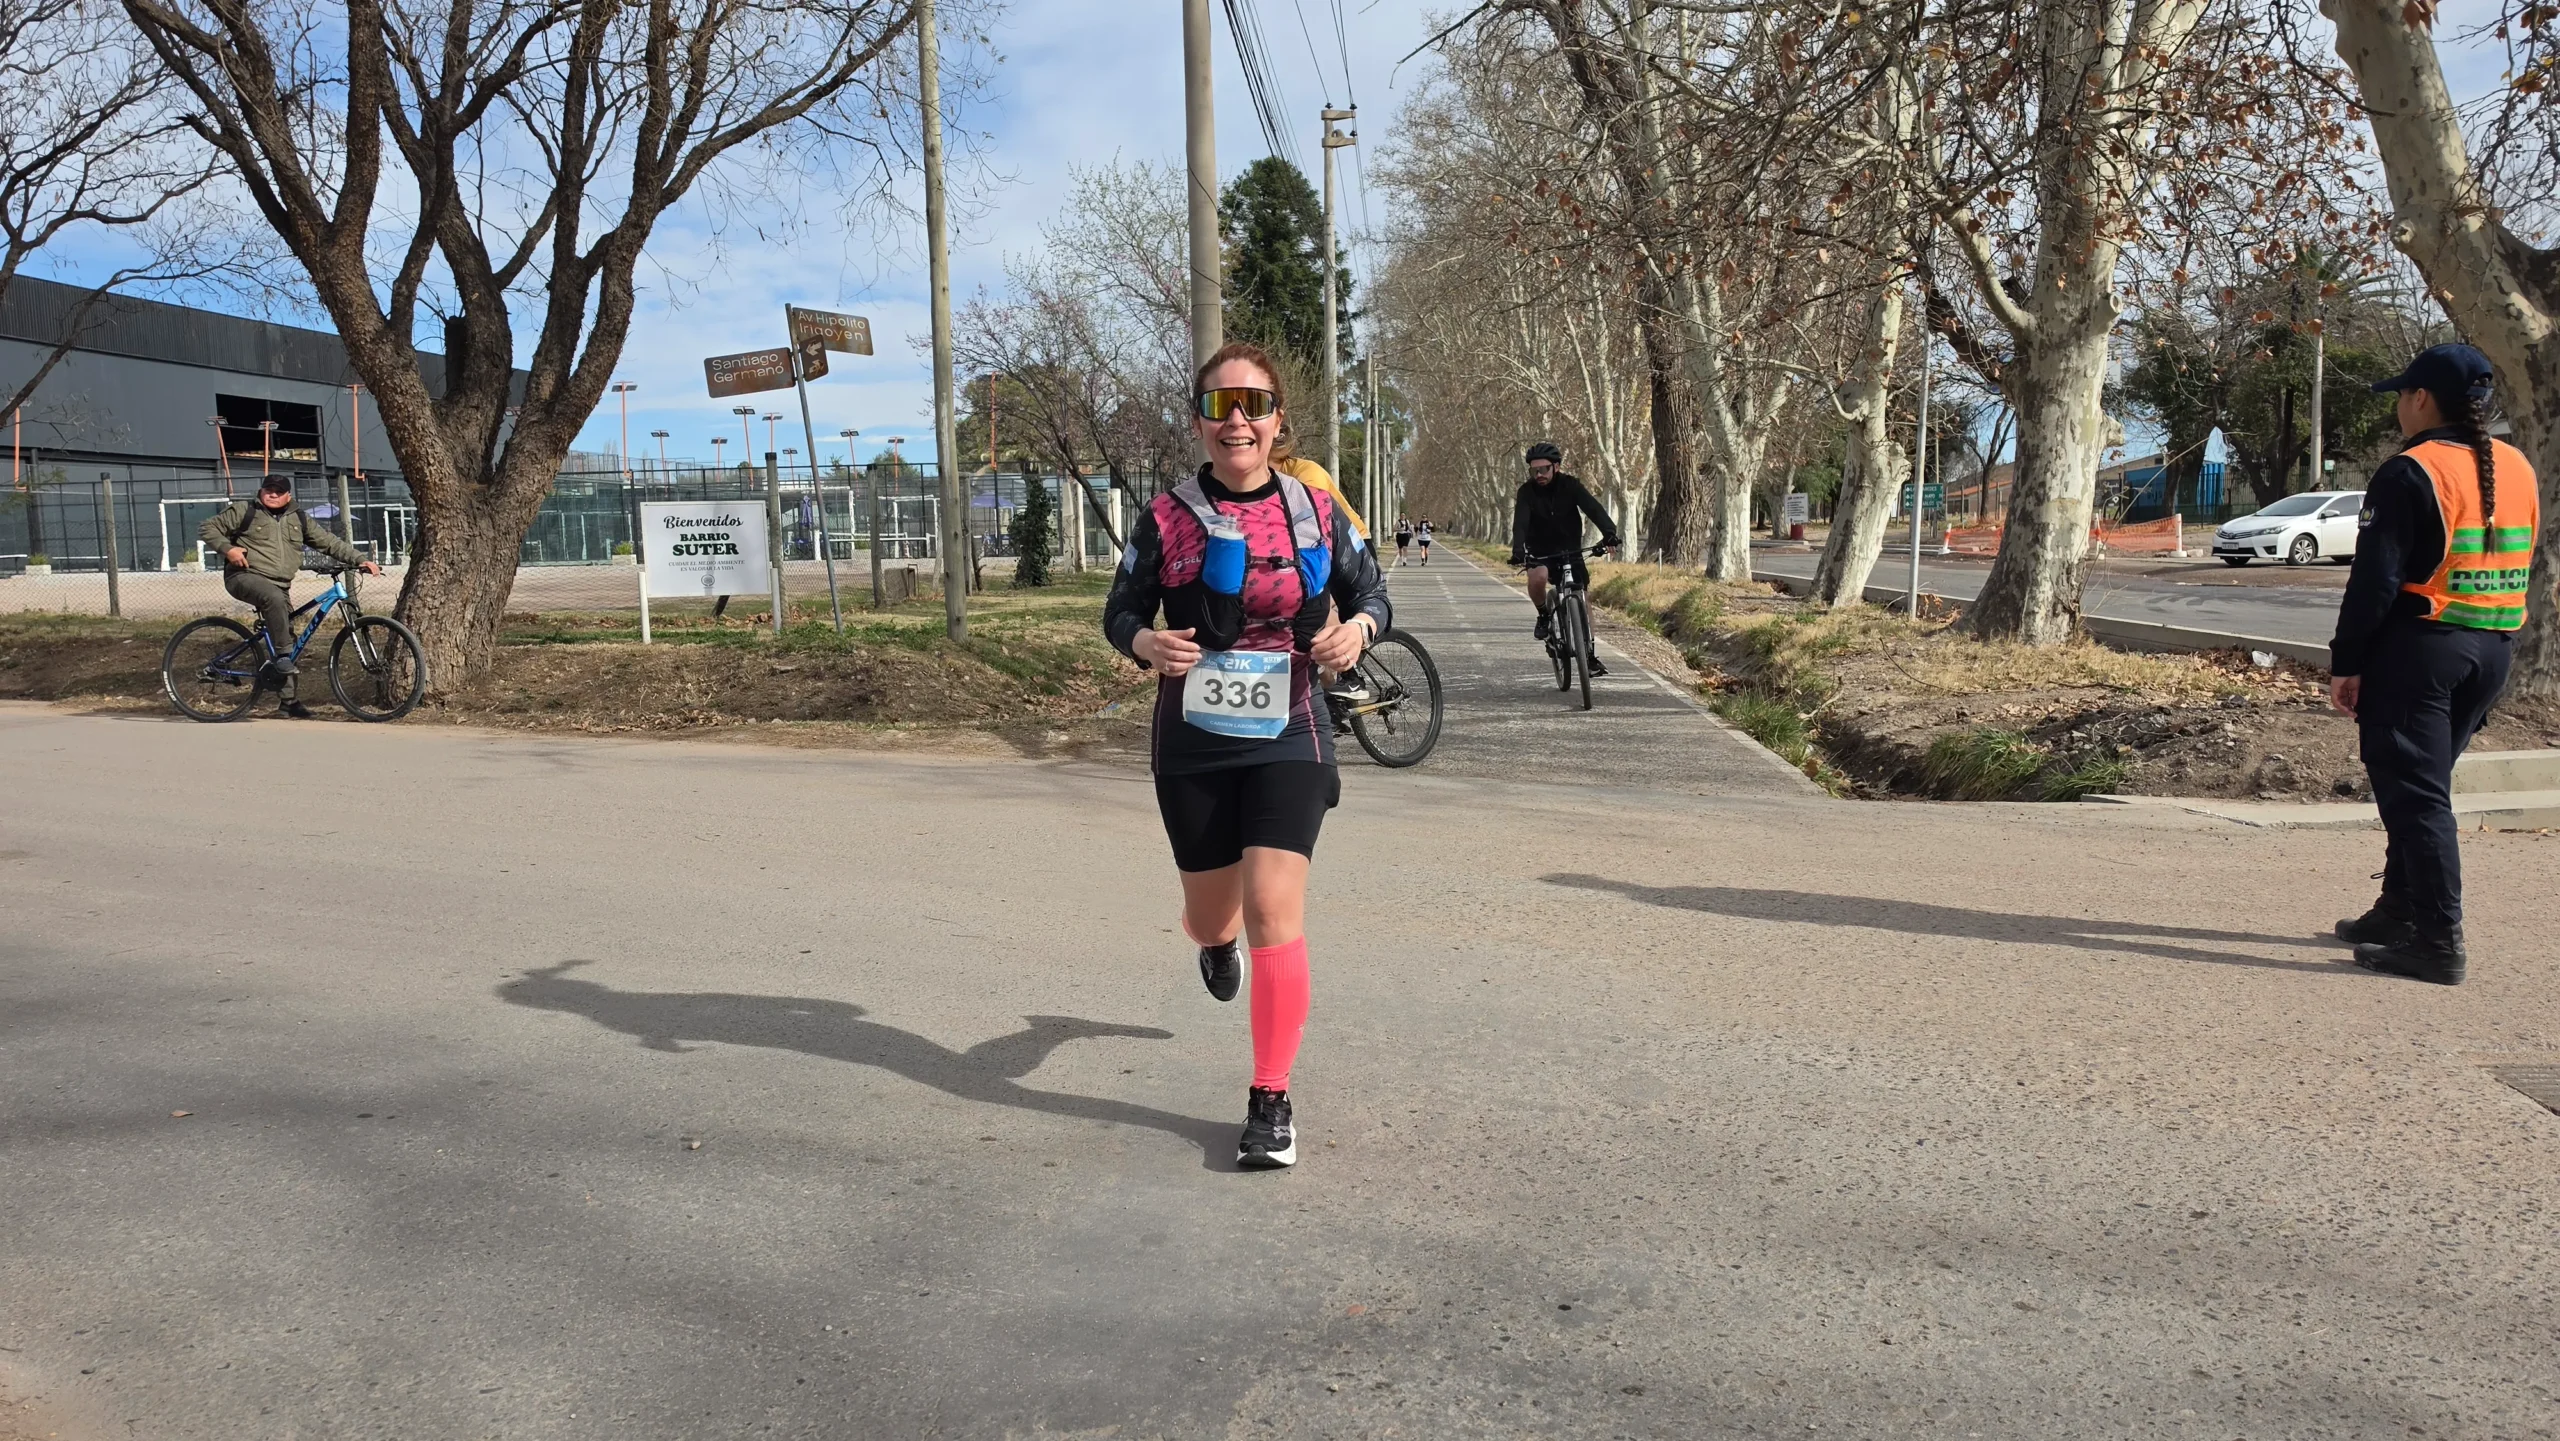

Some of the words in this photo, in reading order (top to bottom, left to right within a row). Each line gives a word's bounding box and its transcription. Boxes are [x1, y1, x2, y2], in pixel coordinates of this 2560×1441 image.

[712, 353, 779, 371] Santiago
[713, 361, 784, 383] Germanó
[663, 514, 744, 529] Bienvenidos
[680, 532, 730, 542] BARRIO
[672, 543, 739, 556] SUTER
[2452, 568, 2529, 591] POLICI
[1224, 658, 1253, 670] 21K
[1203, 678, 1271, 710] 336
